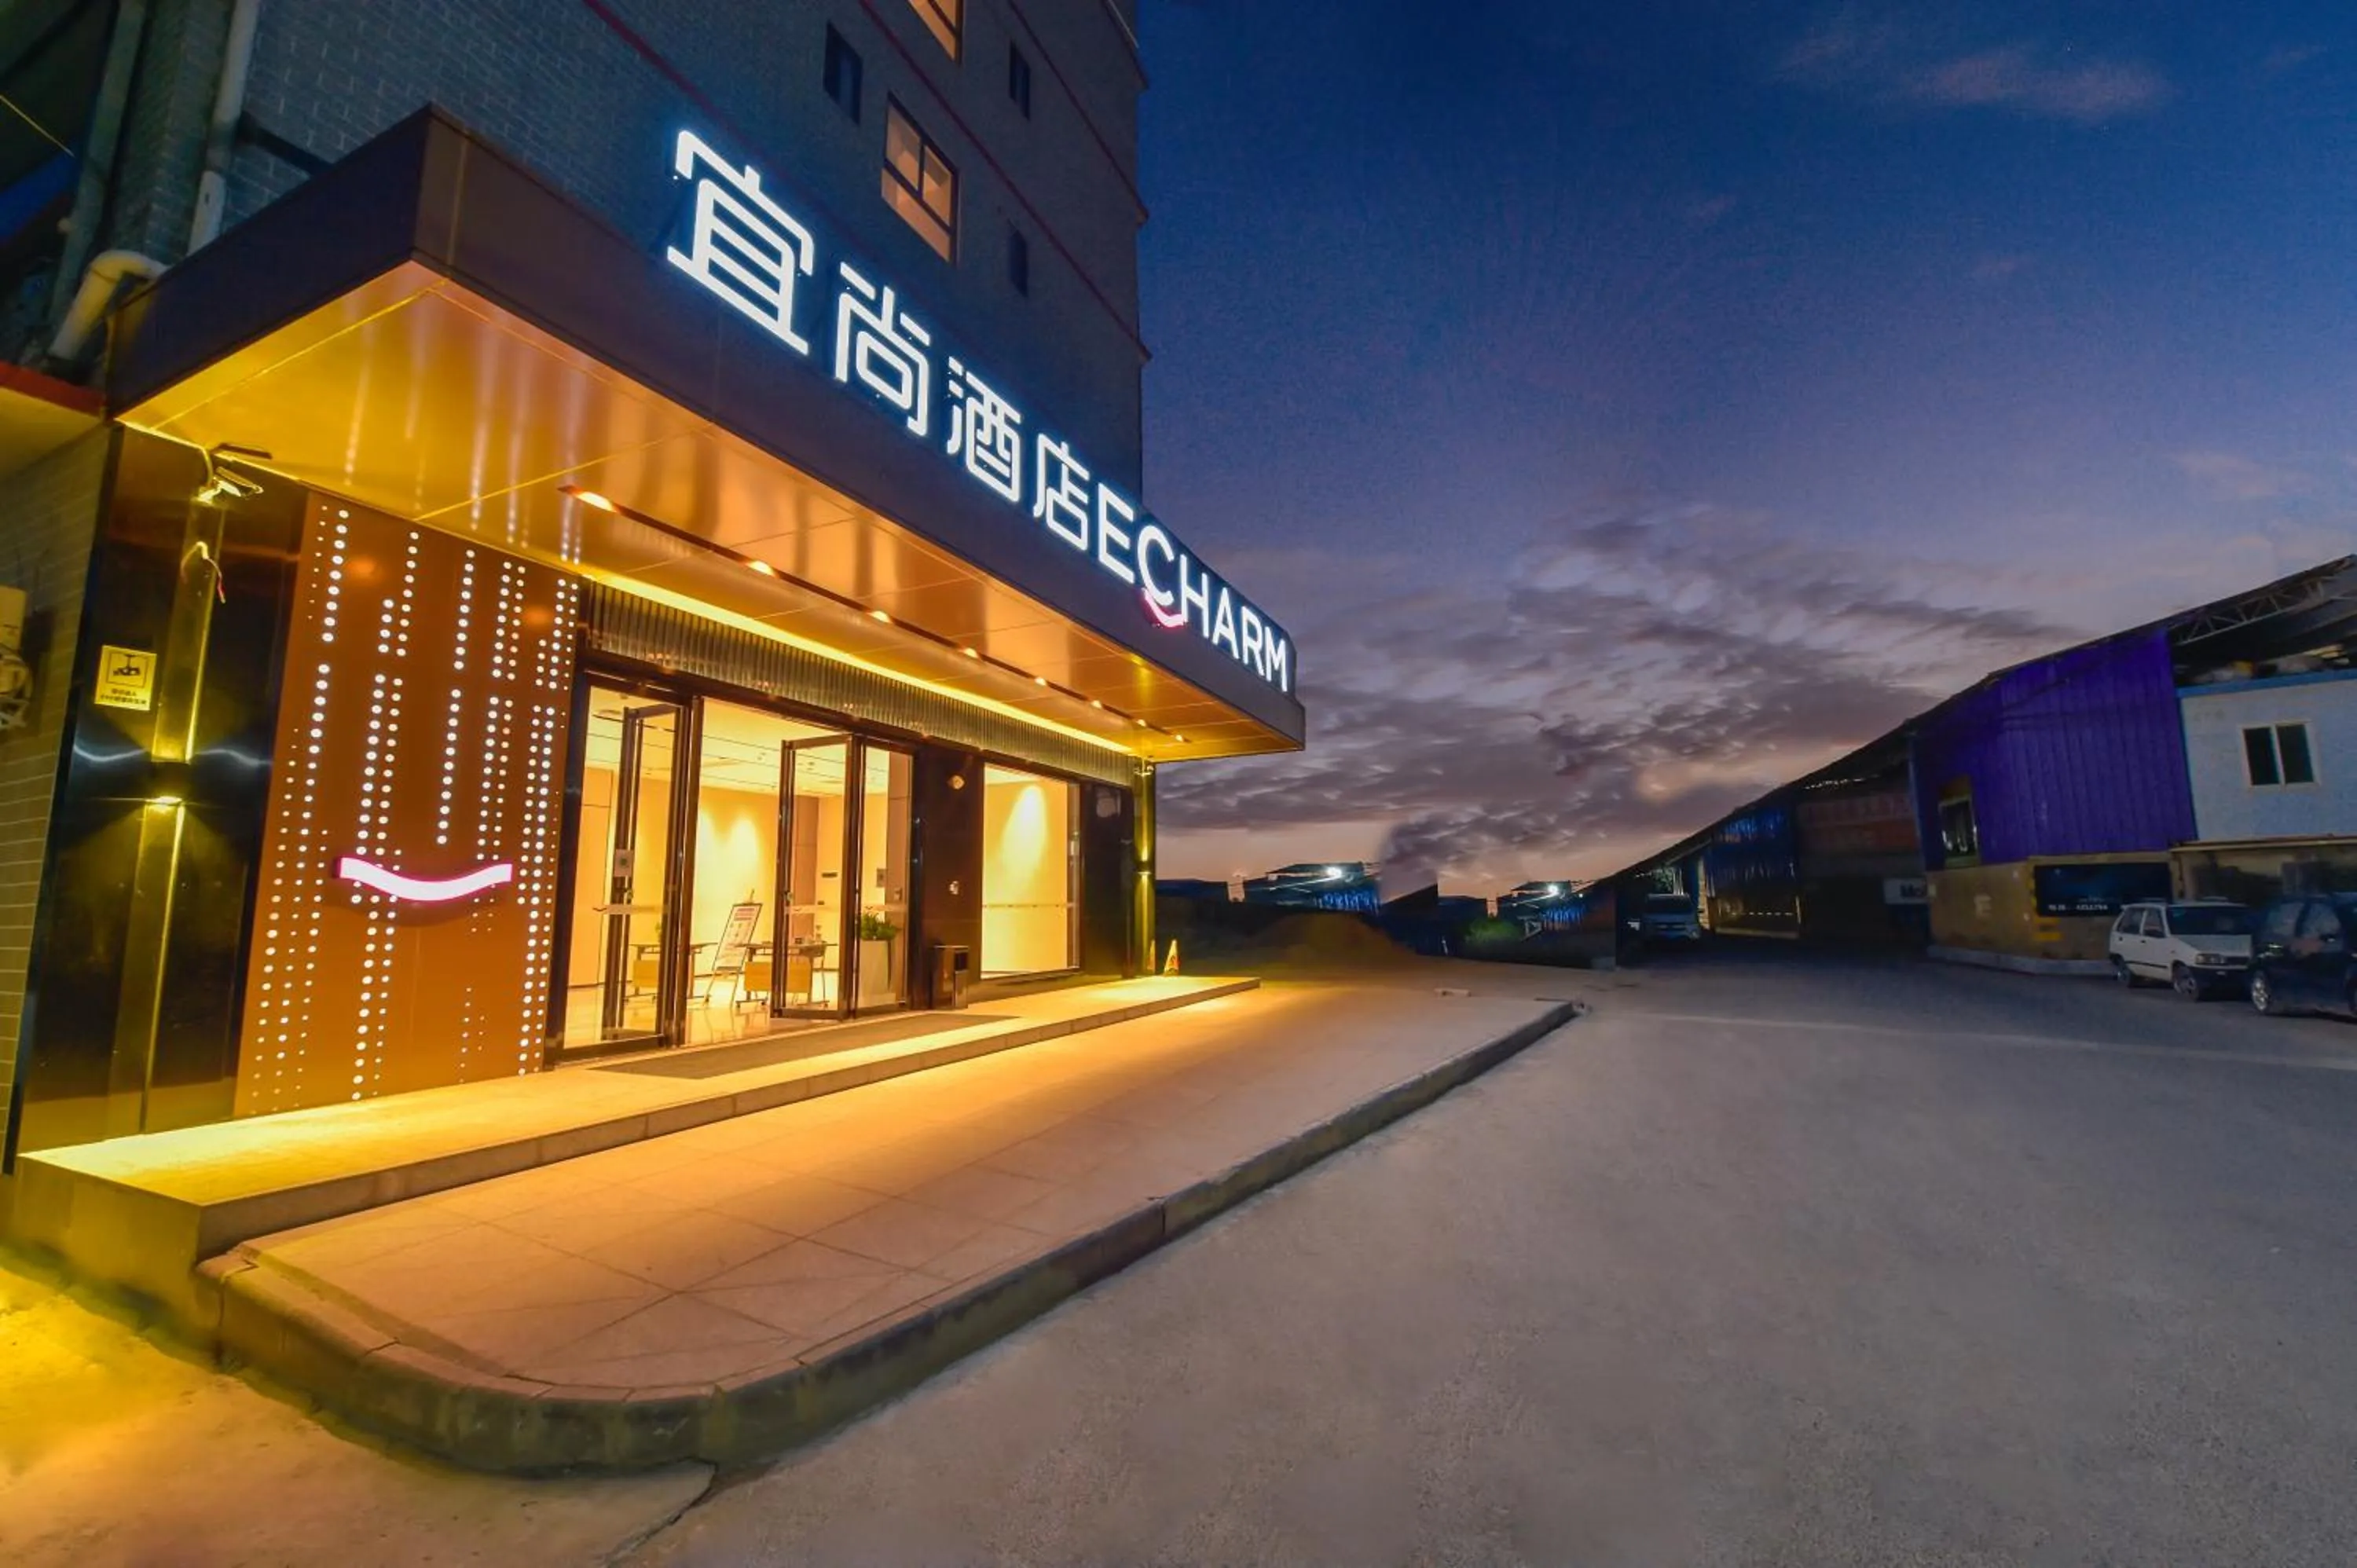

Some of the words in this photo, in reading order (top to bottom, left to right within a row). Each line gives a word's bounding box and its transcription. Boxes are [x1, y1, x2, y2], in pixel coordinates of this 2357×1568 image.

[667, 130, 1089, 551] 宜尚酒店
[1098, 482, 1288, 691] ECHARM
